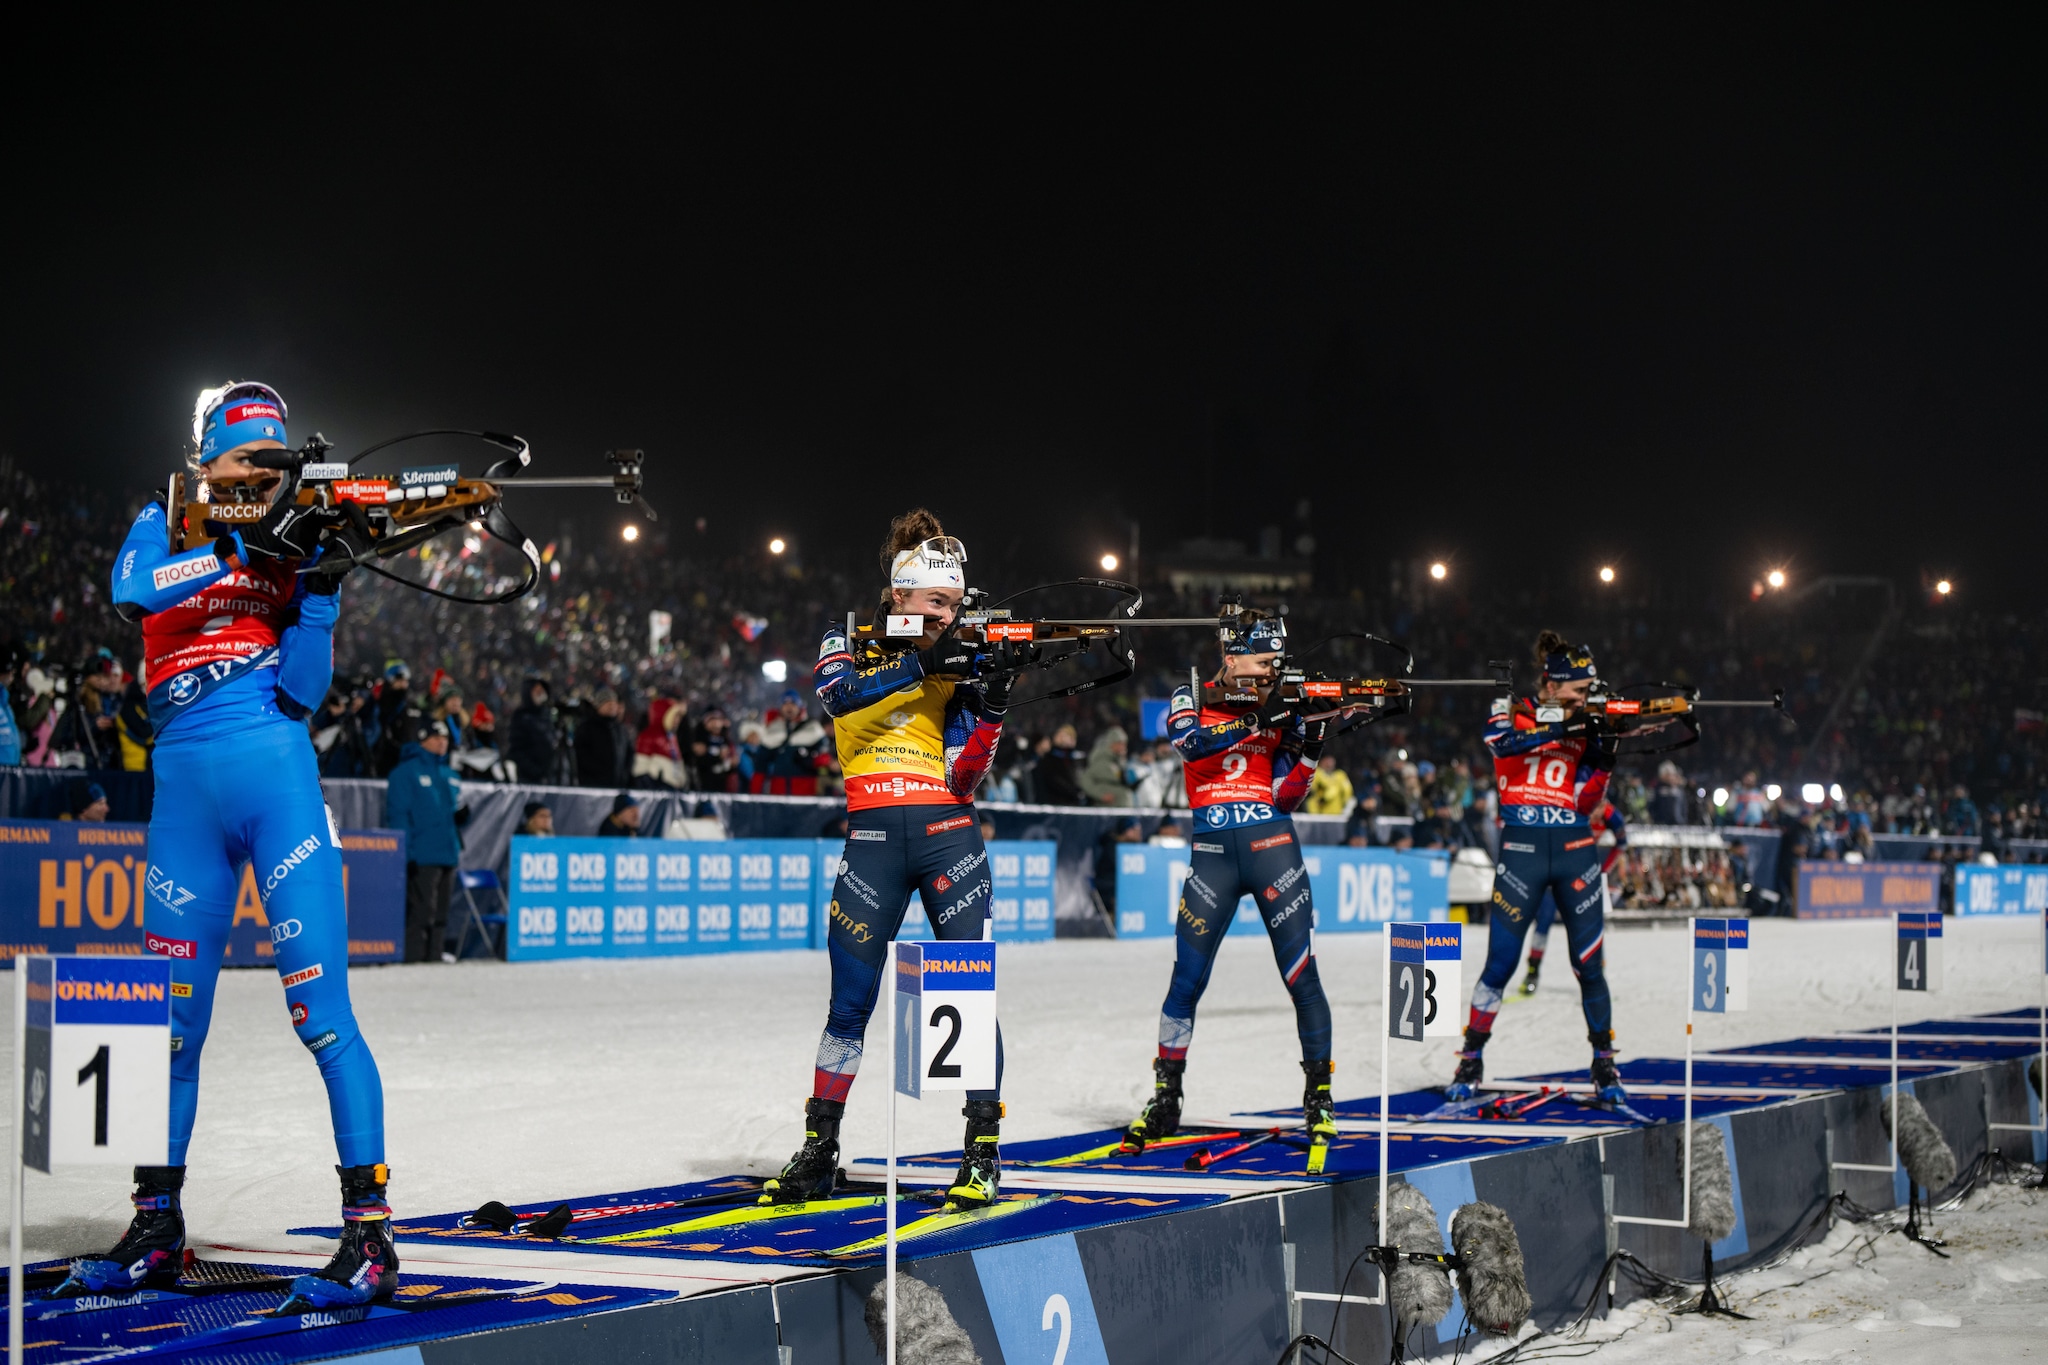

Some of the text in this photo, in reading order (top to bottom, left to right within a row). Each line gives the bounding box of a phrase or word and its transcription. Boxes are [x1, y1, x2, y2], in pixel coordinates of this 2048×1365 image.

[336, 482, 388, 498] VIESSMANN
[402, 468, 457, 485] S.Bernardo
[211, 505, 267, 518] FIOCCHI
[154, 558, 219, 588] FIOCCHI
[208, 597, 270, 615] pumps
[989, 625, 1032, 637] VIESSMANN
[858, 660, 902, 679] somfy
[1304, 684, 1341, 693] VIESSMANN
[1361, 680, 1388, 688] somfy
[854, 746, 875, 757] NOVÉ
[1222, 753, 1247, 781] 9
[1524, 756, 1568, 788] 10
[864, 777, 951, 797] VIESSMAN
[928, 818, 971, 832] VIESSMANN
[1233, 804, 1273, 824] iX3
[1542, 806, 1577, 824] iX3
[0, 828, 50, 844] RMANN
[1253, 835, 1291, 848] VIESSMANN
[262, 834, 322, 911] ALCONERI
[520, 853, 558, 881] DKB
[567, 853, 607, 881] DKB
[615, 854, 649, 881] DKB
[656, 854, 691, 880] DKB
[698, 854, 732, 880] DKB
[947, 853, 976, 878] CAISSE
[952, 849, 987, 884] D'EPARGN
[842, 876, 880, 911] Rhône-Alpes
[848, 870, 879, 898] Auvergne-
[1338, 863, 1395, 922] DKB
[697, 904, 732, 931] DKB
[937, 883, 983, 926] CRAFT
[1179, 897, 1210, 936] omfy
[1270, 894, 1306, 929] CRAFT
[518, 906, 557, 935] DKB
[566, 906, 605, 935] DKB
[613, 906, 648, 934] DKB
[655, 905, 690, 932] DKB
[830, 899, 874, 944] omfy
[148, 936, 191, 958] enel
[1425, 936, 1459, 946] MANN
[1904, 940, 1920, 990] 4
[56, 981, 165, 1001] ÖRMANN
[1703, 952, 1718, 1010] 3
[1399, 966, 1415, 1037] 2
[927, 1004, 962, 1078] 2
[77, 1045, 110, 1147] 1
[774, 1203, 807, 1215] FISCHER
[349, 1258, 373, 1286] SALOMON
[74, 1292, 142, 1313] SALOMON
[300, 1307, 364, 1330] SALOMON
[1042, 1293, 1072, 1365] 2
